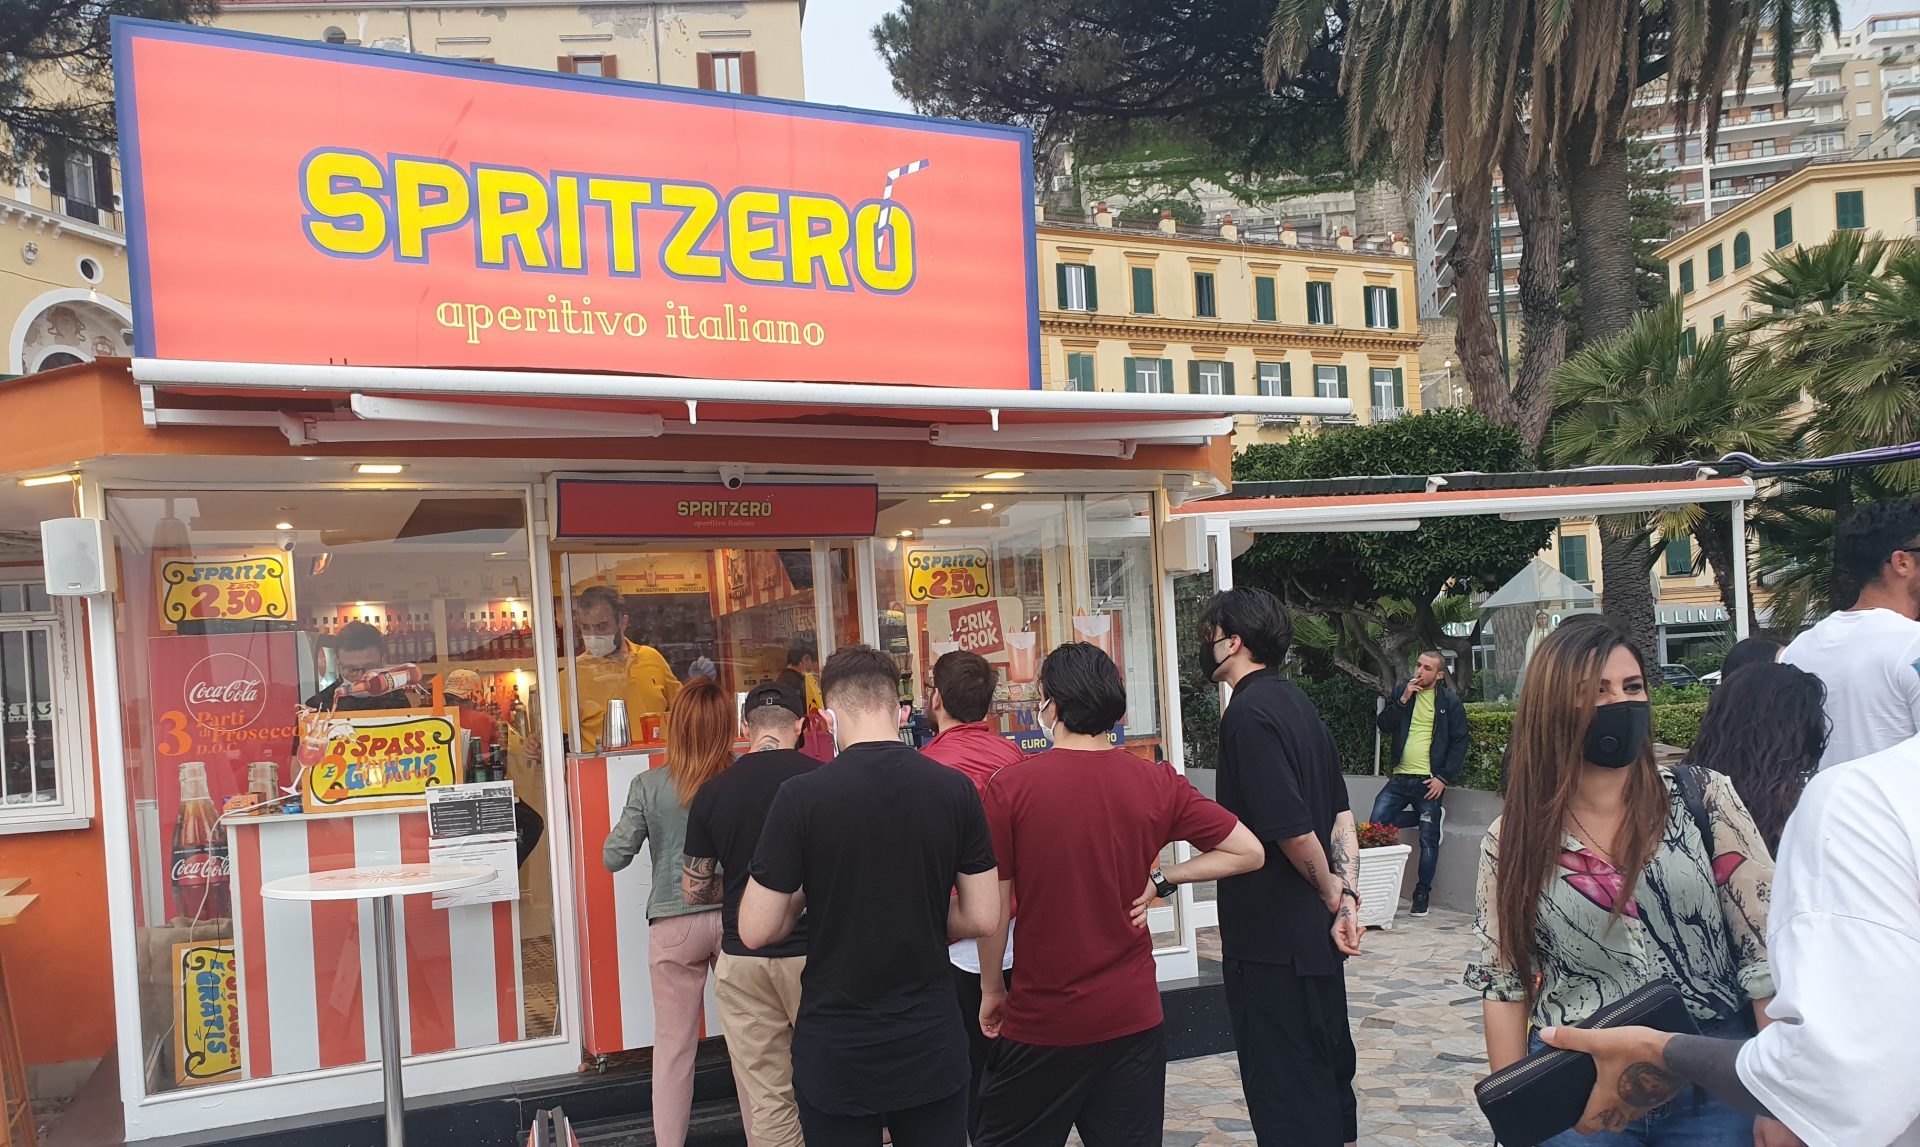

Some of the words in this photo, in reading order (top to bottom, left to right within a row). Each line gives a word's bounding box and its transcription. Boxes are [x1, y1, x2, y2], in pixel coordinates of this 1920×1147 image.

[436, 293, 649, 344] aperitivo
[664, 300, 825, 346] italiano
[186, 564, 267, 582] SPRITZ
[920, 554, 976, 571] SPRITZ
[929, 570, 976, 597] 2.50
[190, 583, 263, 618] 2.50
[958, 609, 994, 633] CRIK
[1660, 608, 1725, 625] LLINA
[958, 627, 999, 652] CROK
[197, 710, 245, 728] Parti
[157, 710, 192, 756] 3
[199, 729, 211, 738] di
[211, 726, 304, 743] Prosecco
[1021, 738, 1047, 749] EURO
[320, 754, 349, 799] 2
[345, 753, 438, 791] GATIS
[196, 971, 228, 1054] GRATIS
